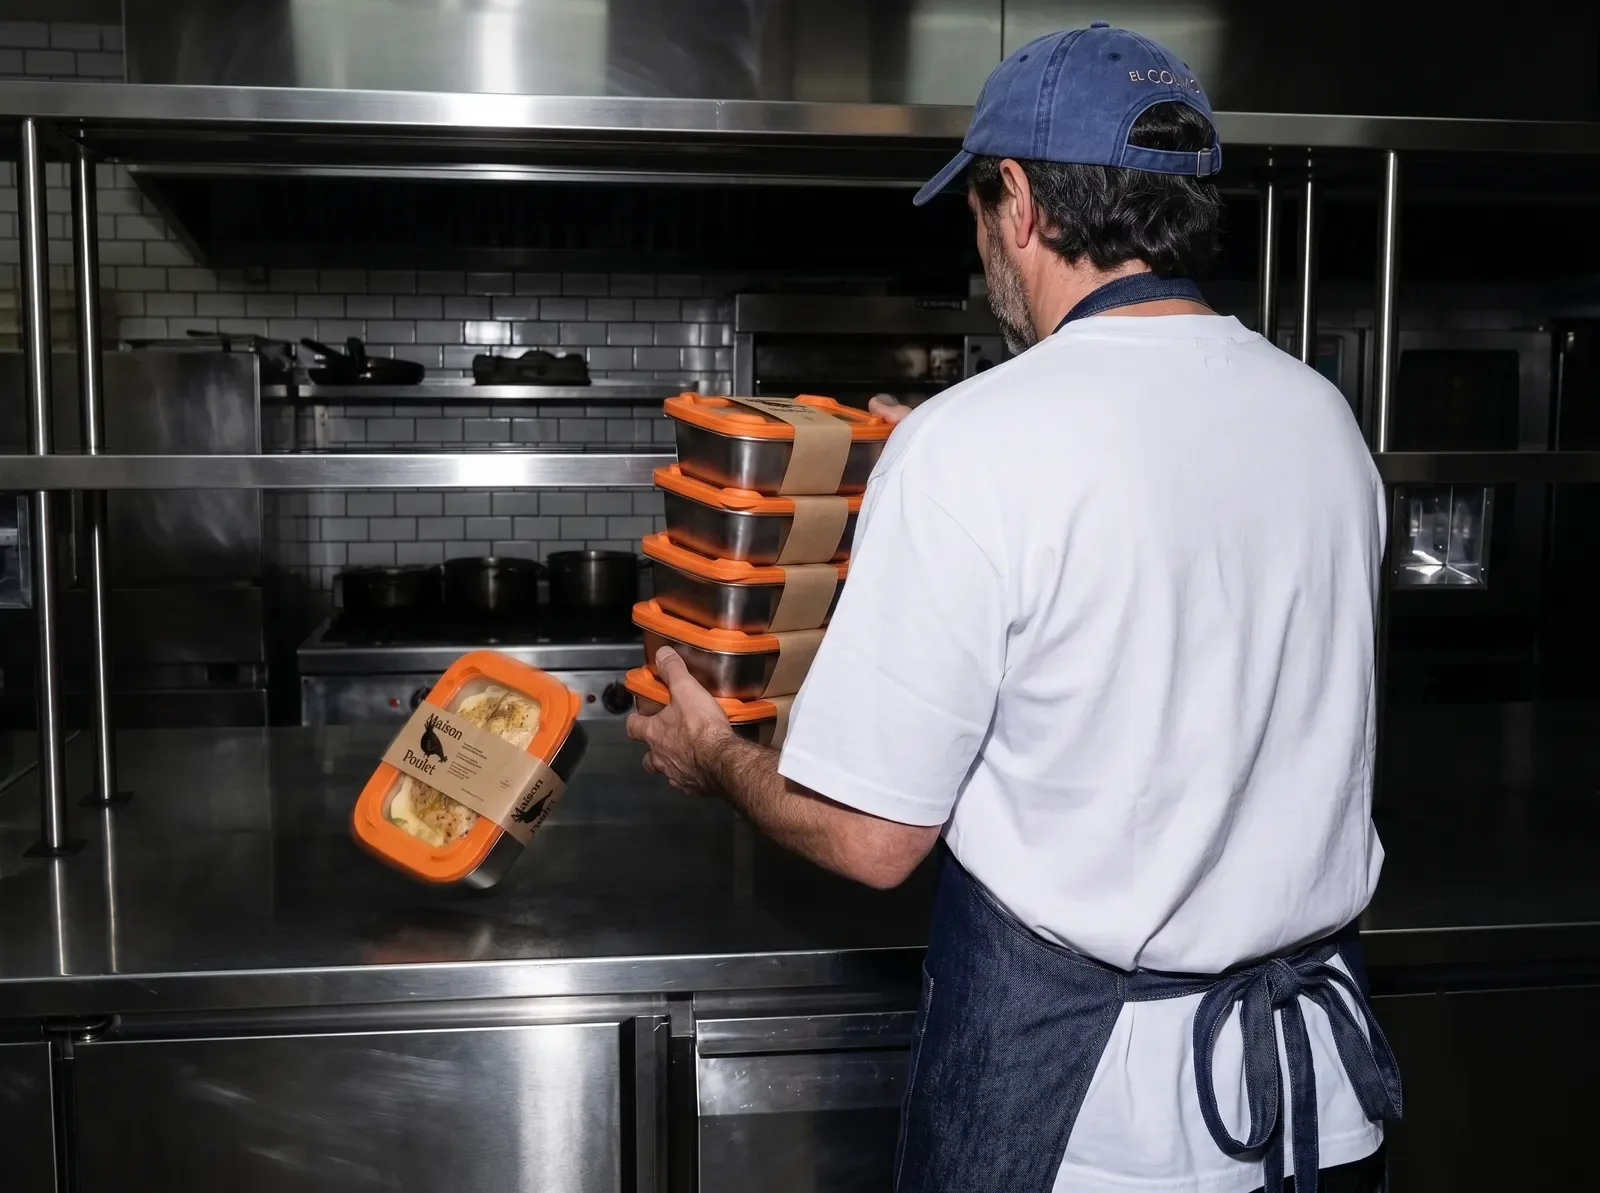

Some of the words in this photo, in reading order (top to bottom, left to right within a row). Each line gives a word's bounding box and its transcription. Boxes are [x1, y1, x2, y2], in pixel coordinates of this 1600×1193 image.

[1129, 70, 1145, 82] EL
[425, 713, 463, 741] Maison
[402, 749, 436, 776] Poulet
[510, 779, 544, 823] Maison
